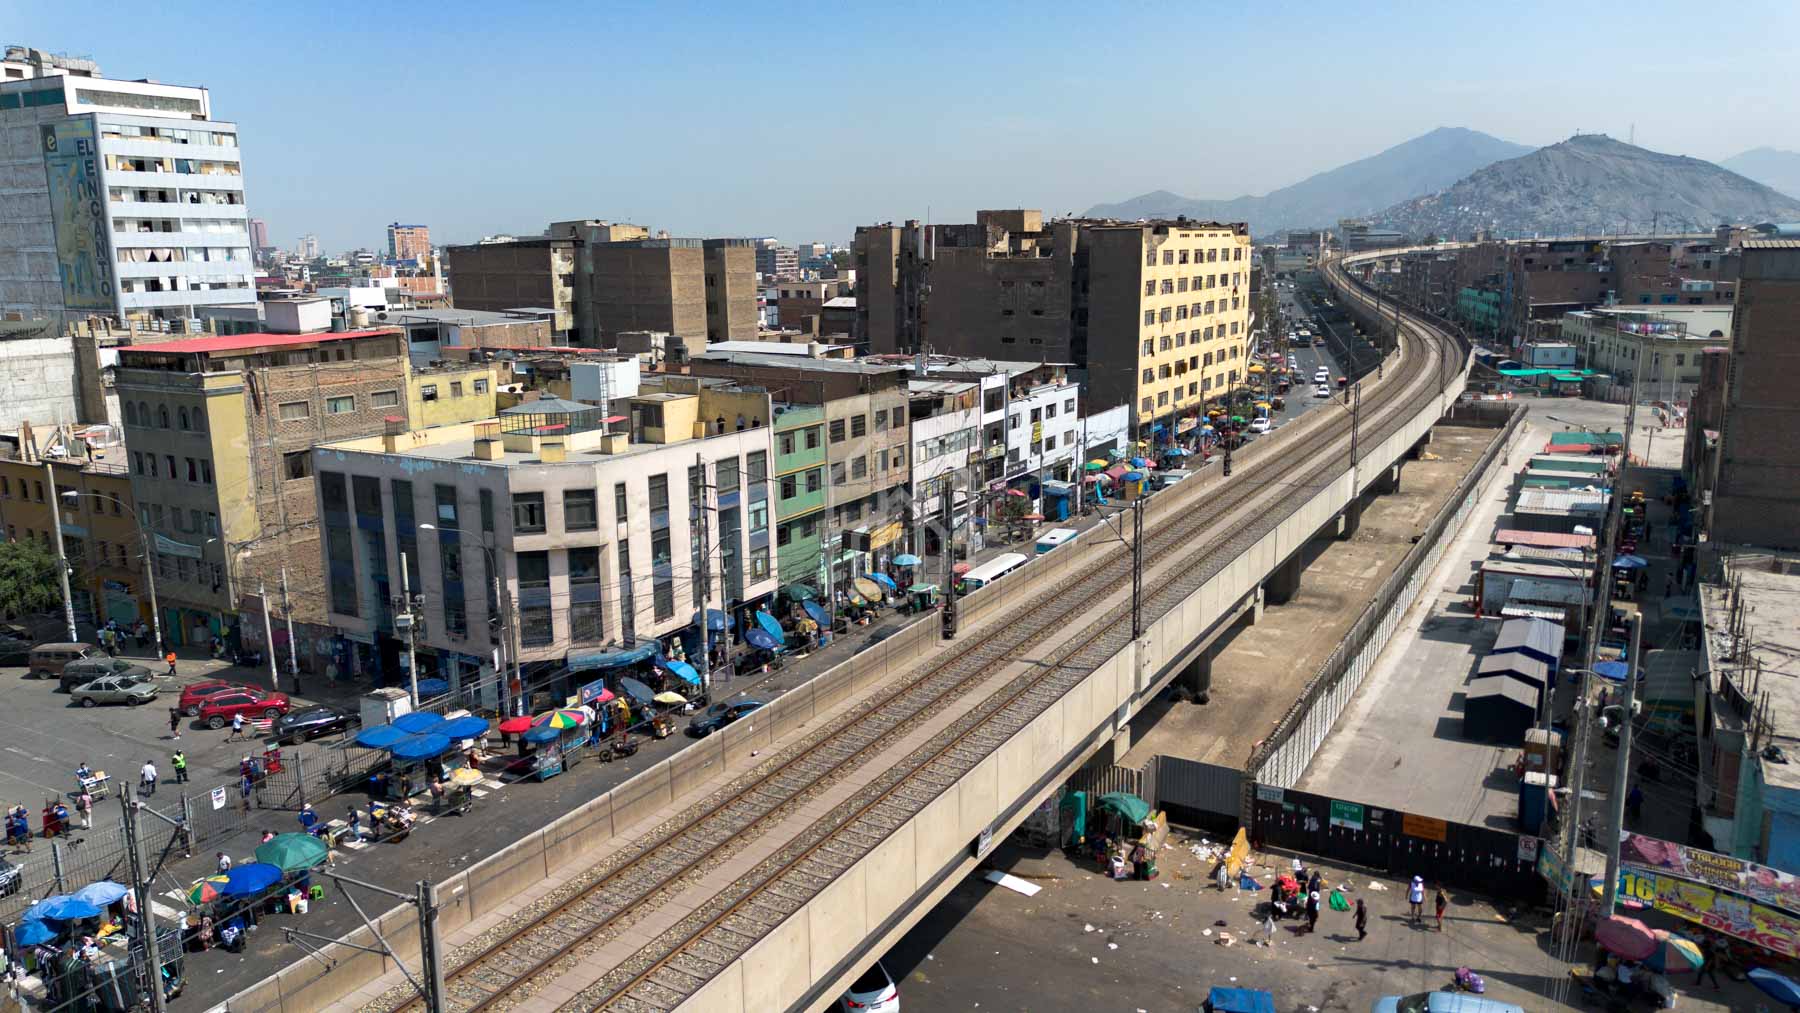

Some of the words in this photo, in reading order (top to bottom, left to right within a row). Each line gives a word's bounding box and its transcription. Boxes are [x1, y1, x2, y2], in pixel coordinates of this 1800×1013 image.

[76, 139, 94, 156] EL
[86, 160, 110, 296] ENCANTO
[1622, 873, 1654, 901] 16
